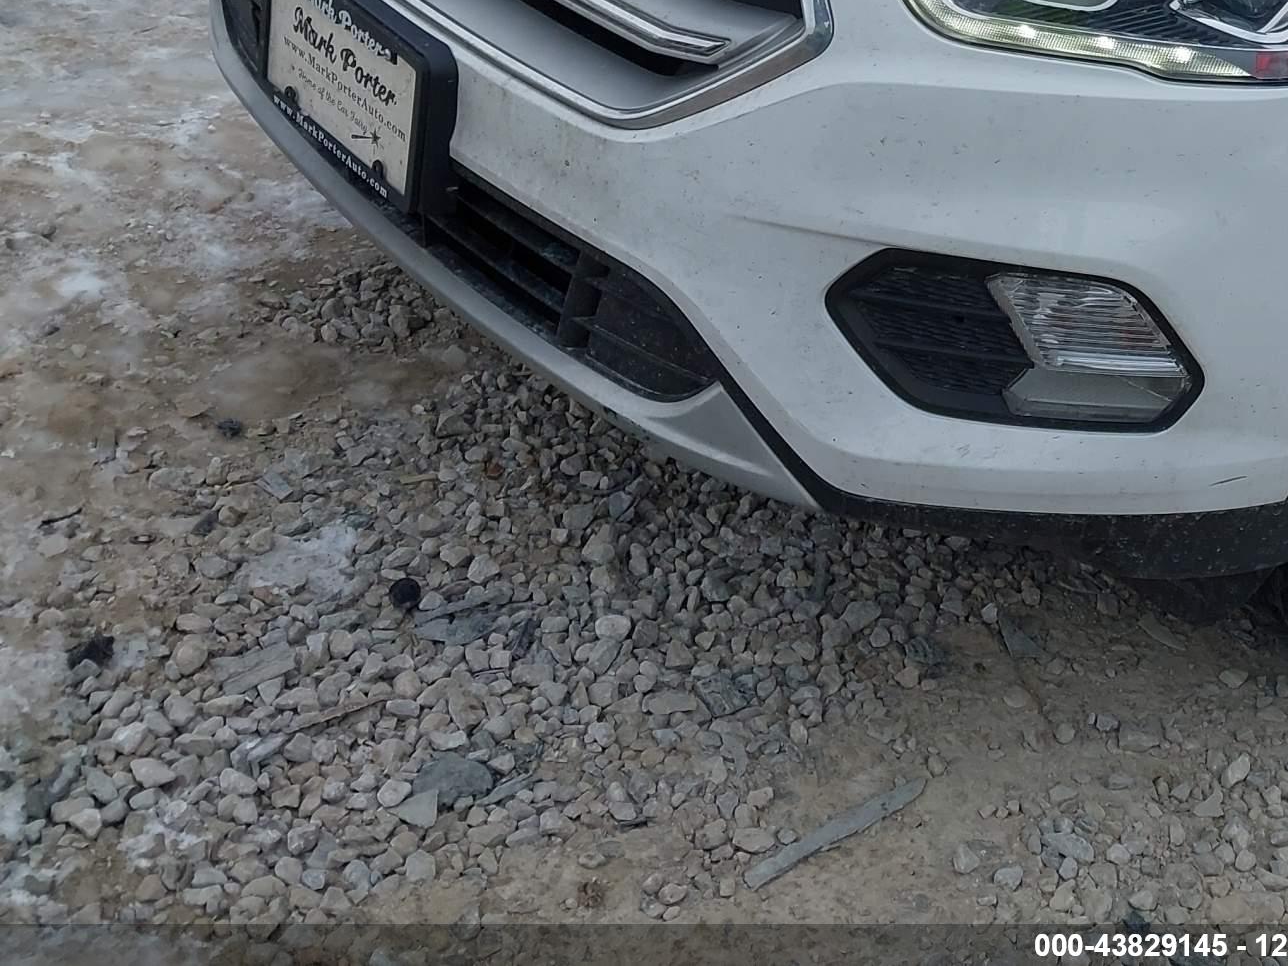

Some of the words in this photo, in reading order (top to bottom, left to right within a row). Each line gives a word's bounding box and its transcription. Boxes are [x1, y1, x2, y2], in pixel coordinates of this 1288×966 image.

[292, 6, 338, 64] Mark
[283, 35, 406, 143] www.MarkPorterAuto.com
[273, 94, 388, 199] www.MarkPorterAuto.com
